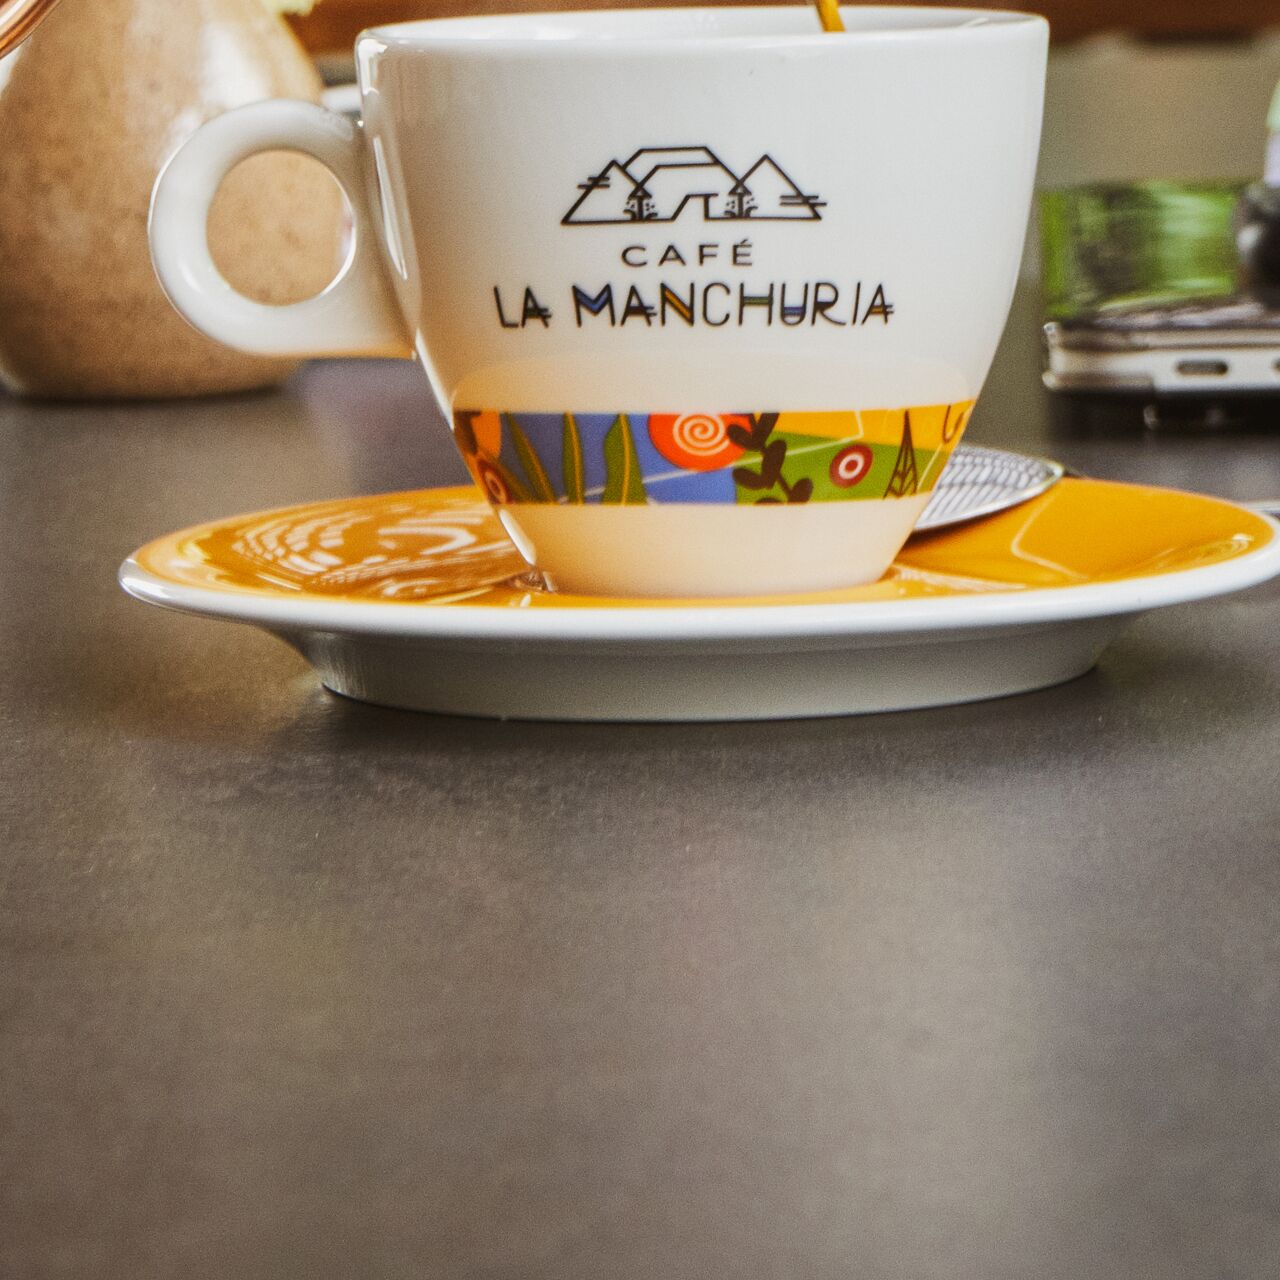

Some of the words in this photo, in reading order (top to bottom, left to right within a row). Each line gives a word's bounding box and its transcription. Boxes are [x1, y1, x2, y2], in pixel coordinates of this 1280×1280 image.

[621, 238, 754, 267] CAFÉ
[493, 286, 553, 329] LA
[571, 281, 895, 328] MANCHURIA
